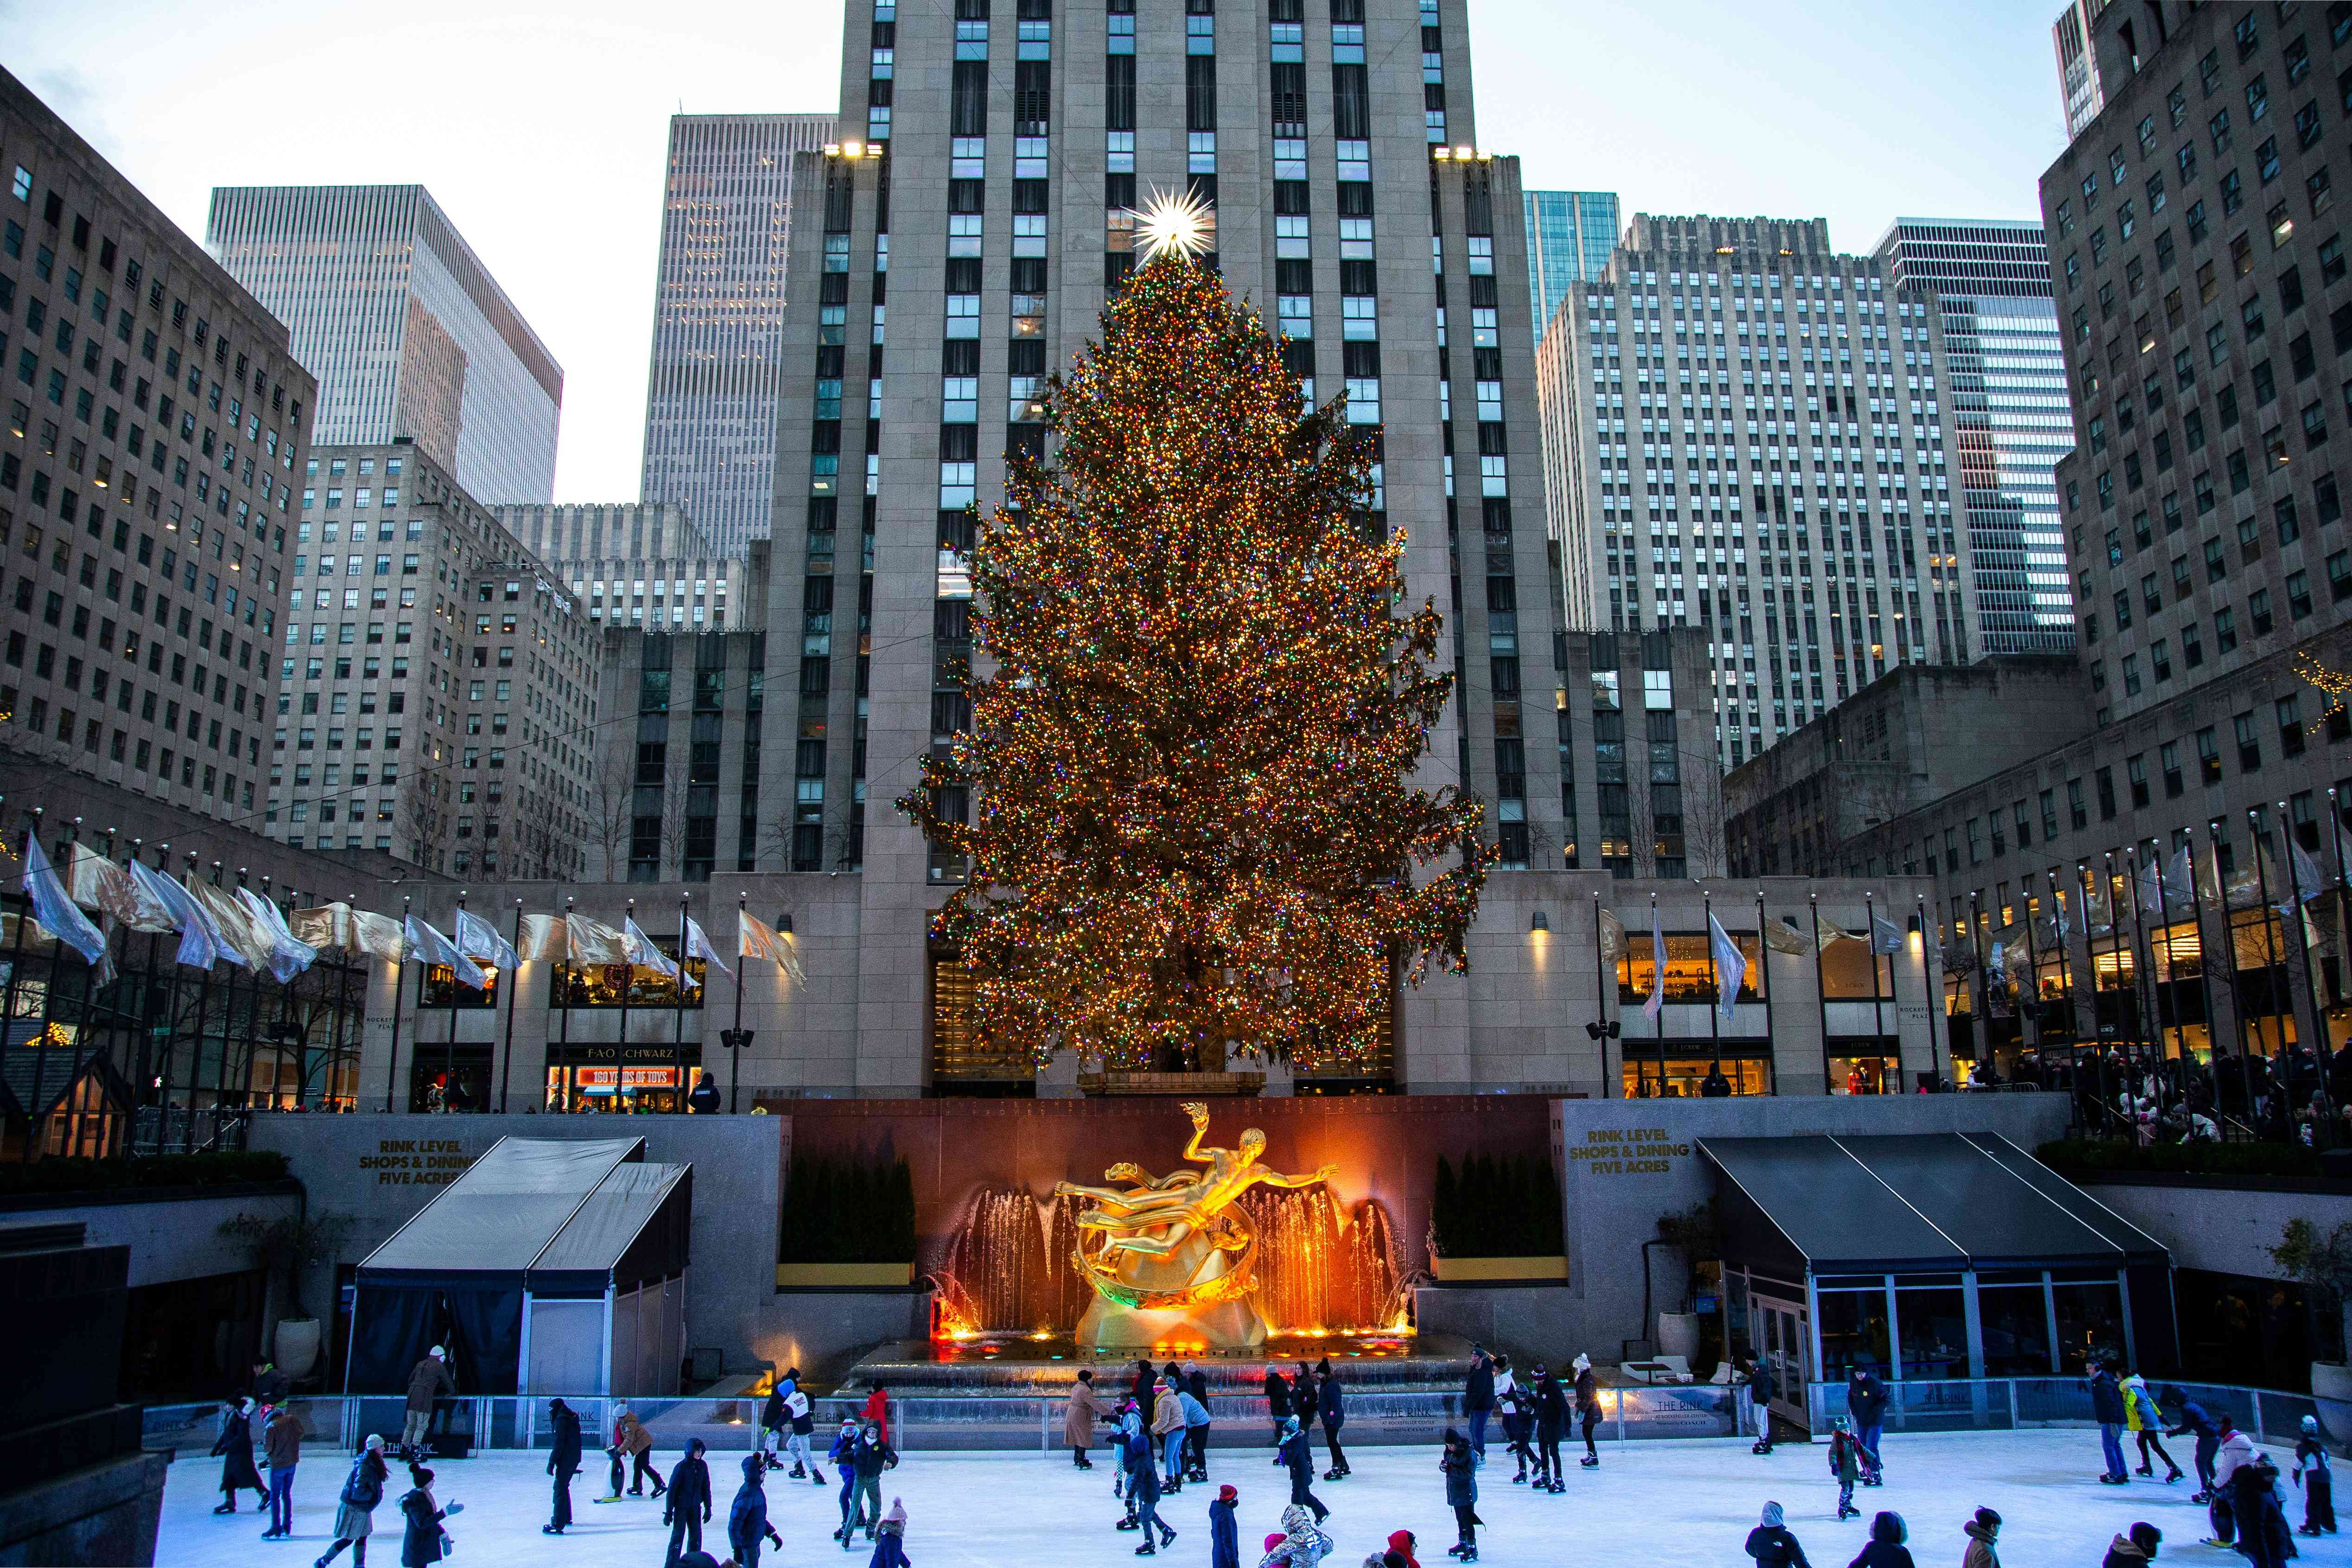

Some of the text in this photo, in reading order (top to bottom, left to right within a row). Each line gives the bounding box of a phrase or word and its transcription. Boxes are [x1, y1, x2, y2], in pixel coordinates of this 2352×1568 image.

[623, 1049, 674, 1058] CHWARZ
[593, 1071, 608, 1083] 160
[636, 1071, 647, 1083] OF
[647, 1071, 667, 1083] TOYS
[1588, 1129, 1669, 1143] RINK LEVEL
[380, 1140, 462, 1153] RINK LEVEL
[1570, 1144, 1690, 1160] SHOPS & DINING
[359, 1156, 408, 1168] SHOPS
[412, 1156, 422, 1168] &
[1591, 1160, 1670, 1174] FIVE ACRES
[379, 1172, 459, 1185] FIVE ACRES
[1385, 1407, 1431, 1417] THE RINK
[1657, 1401, 1703, 1411] THE RINK
